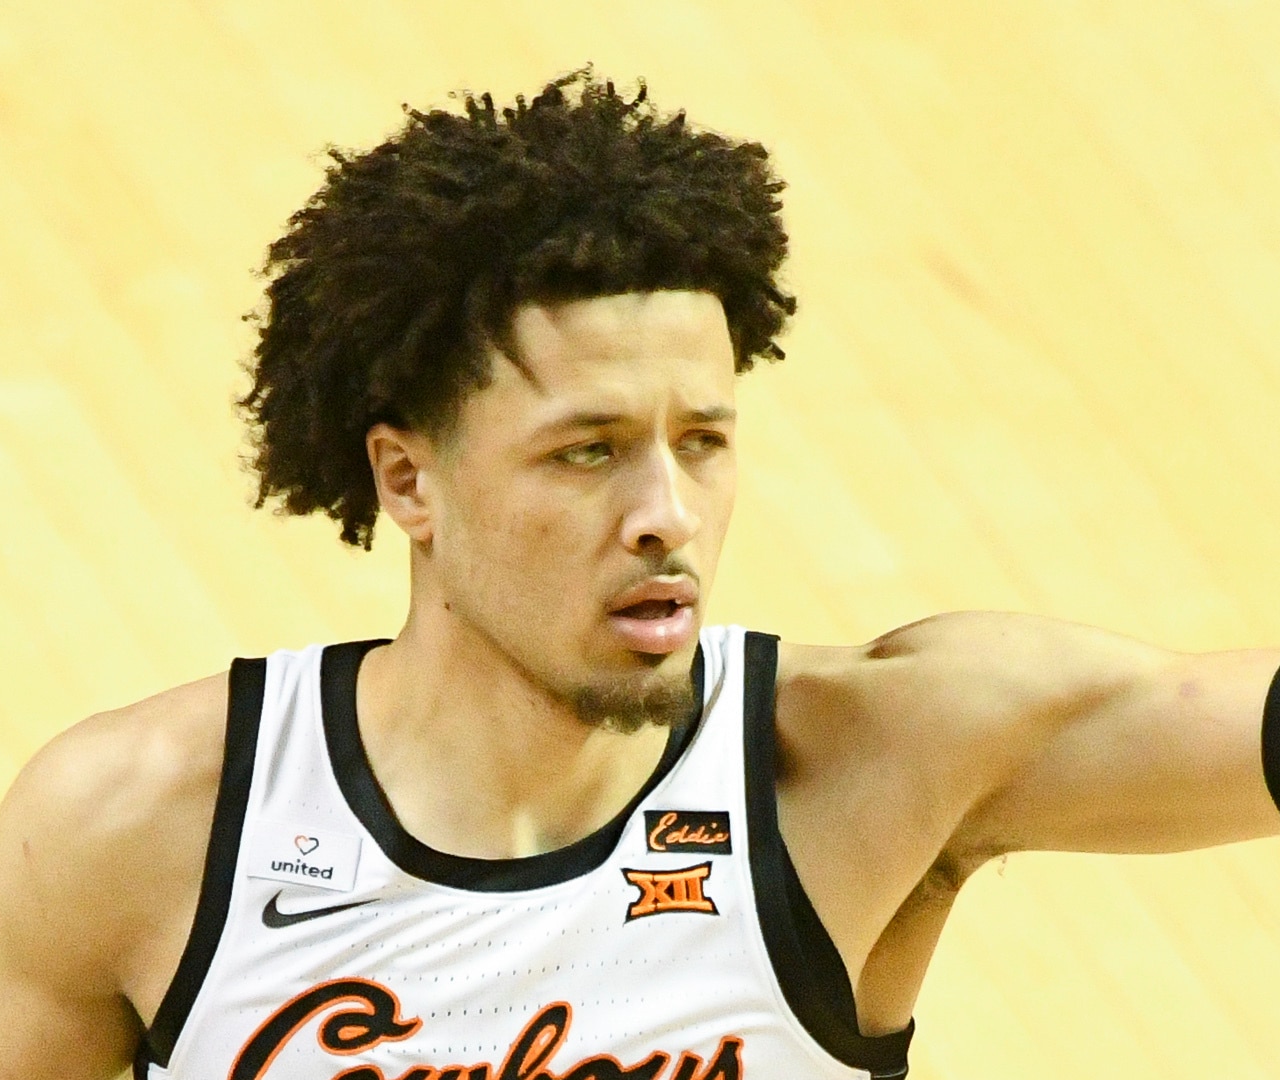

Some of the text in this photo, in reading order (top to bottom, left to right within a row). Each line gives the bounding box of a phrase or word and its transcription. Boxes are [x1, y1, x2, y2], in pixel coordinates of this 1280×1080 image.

[649, 812, 729, 851] Eddie
[271, 858, 334, 880] united
[623, 863, 718, 921] XII
